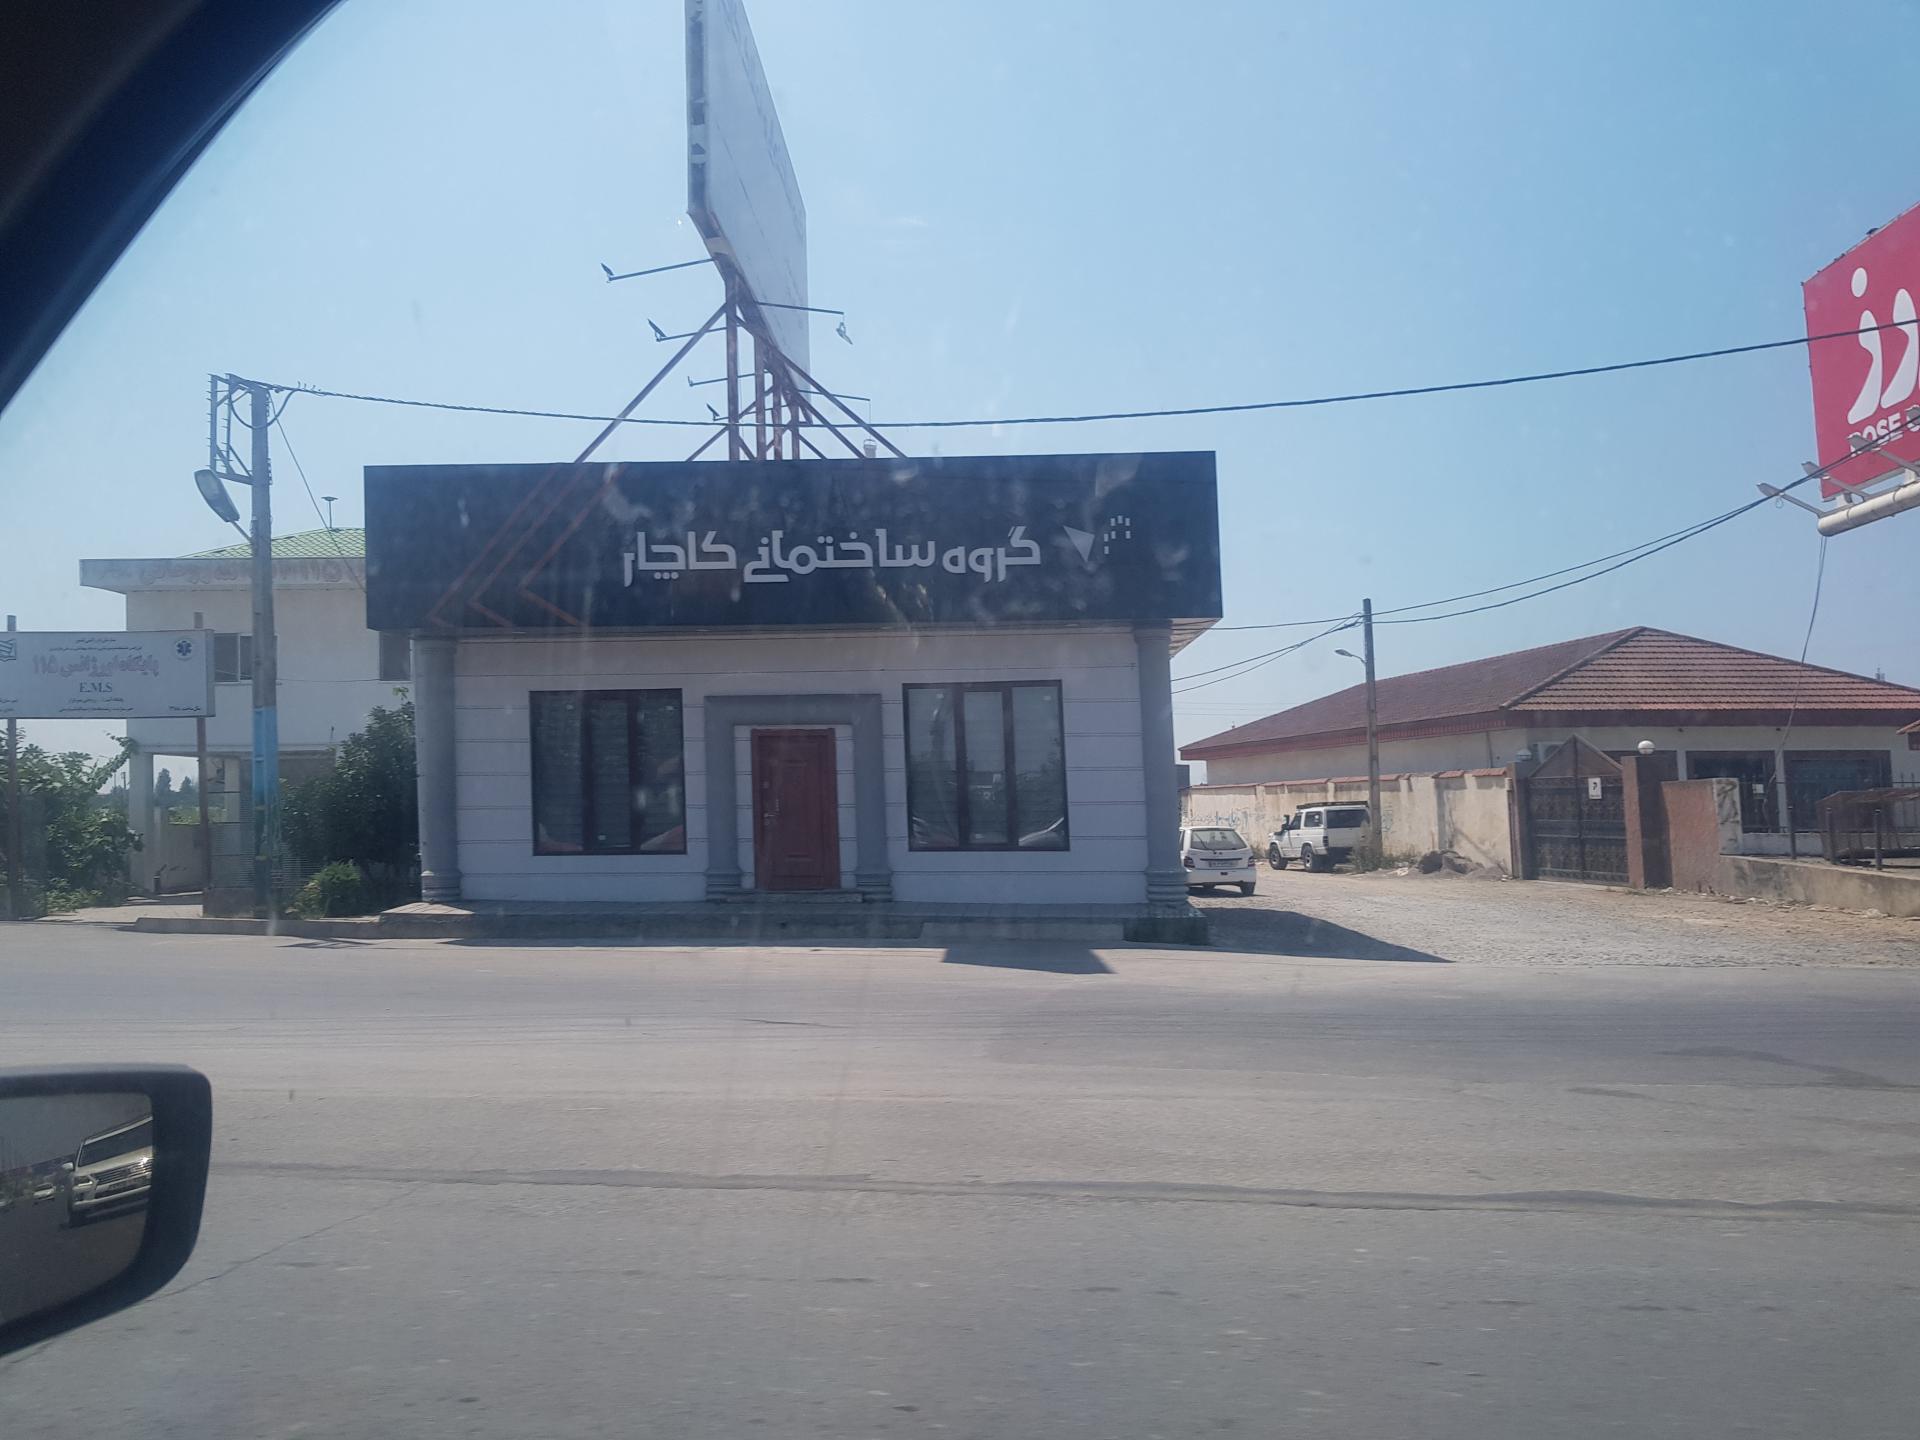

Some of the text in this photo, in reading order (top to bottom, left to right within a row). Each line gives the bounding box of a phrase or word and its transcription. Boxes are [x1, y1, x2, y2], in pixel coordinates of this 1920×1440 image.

[623, 525, 1041, 588] گروه ساختمانی کاچار
